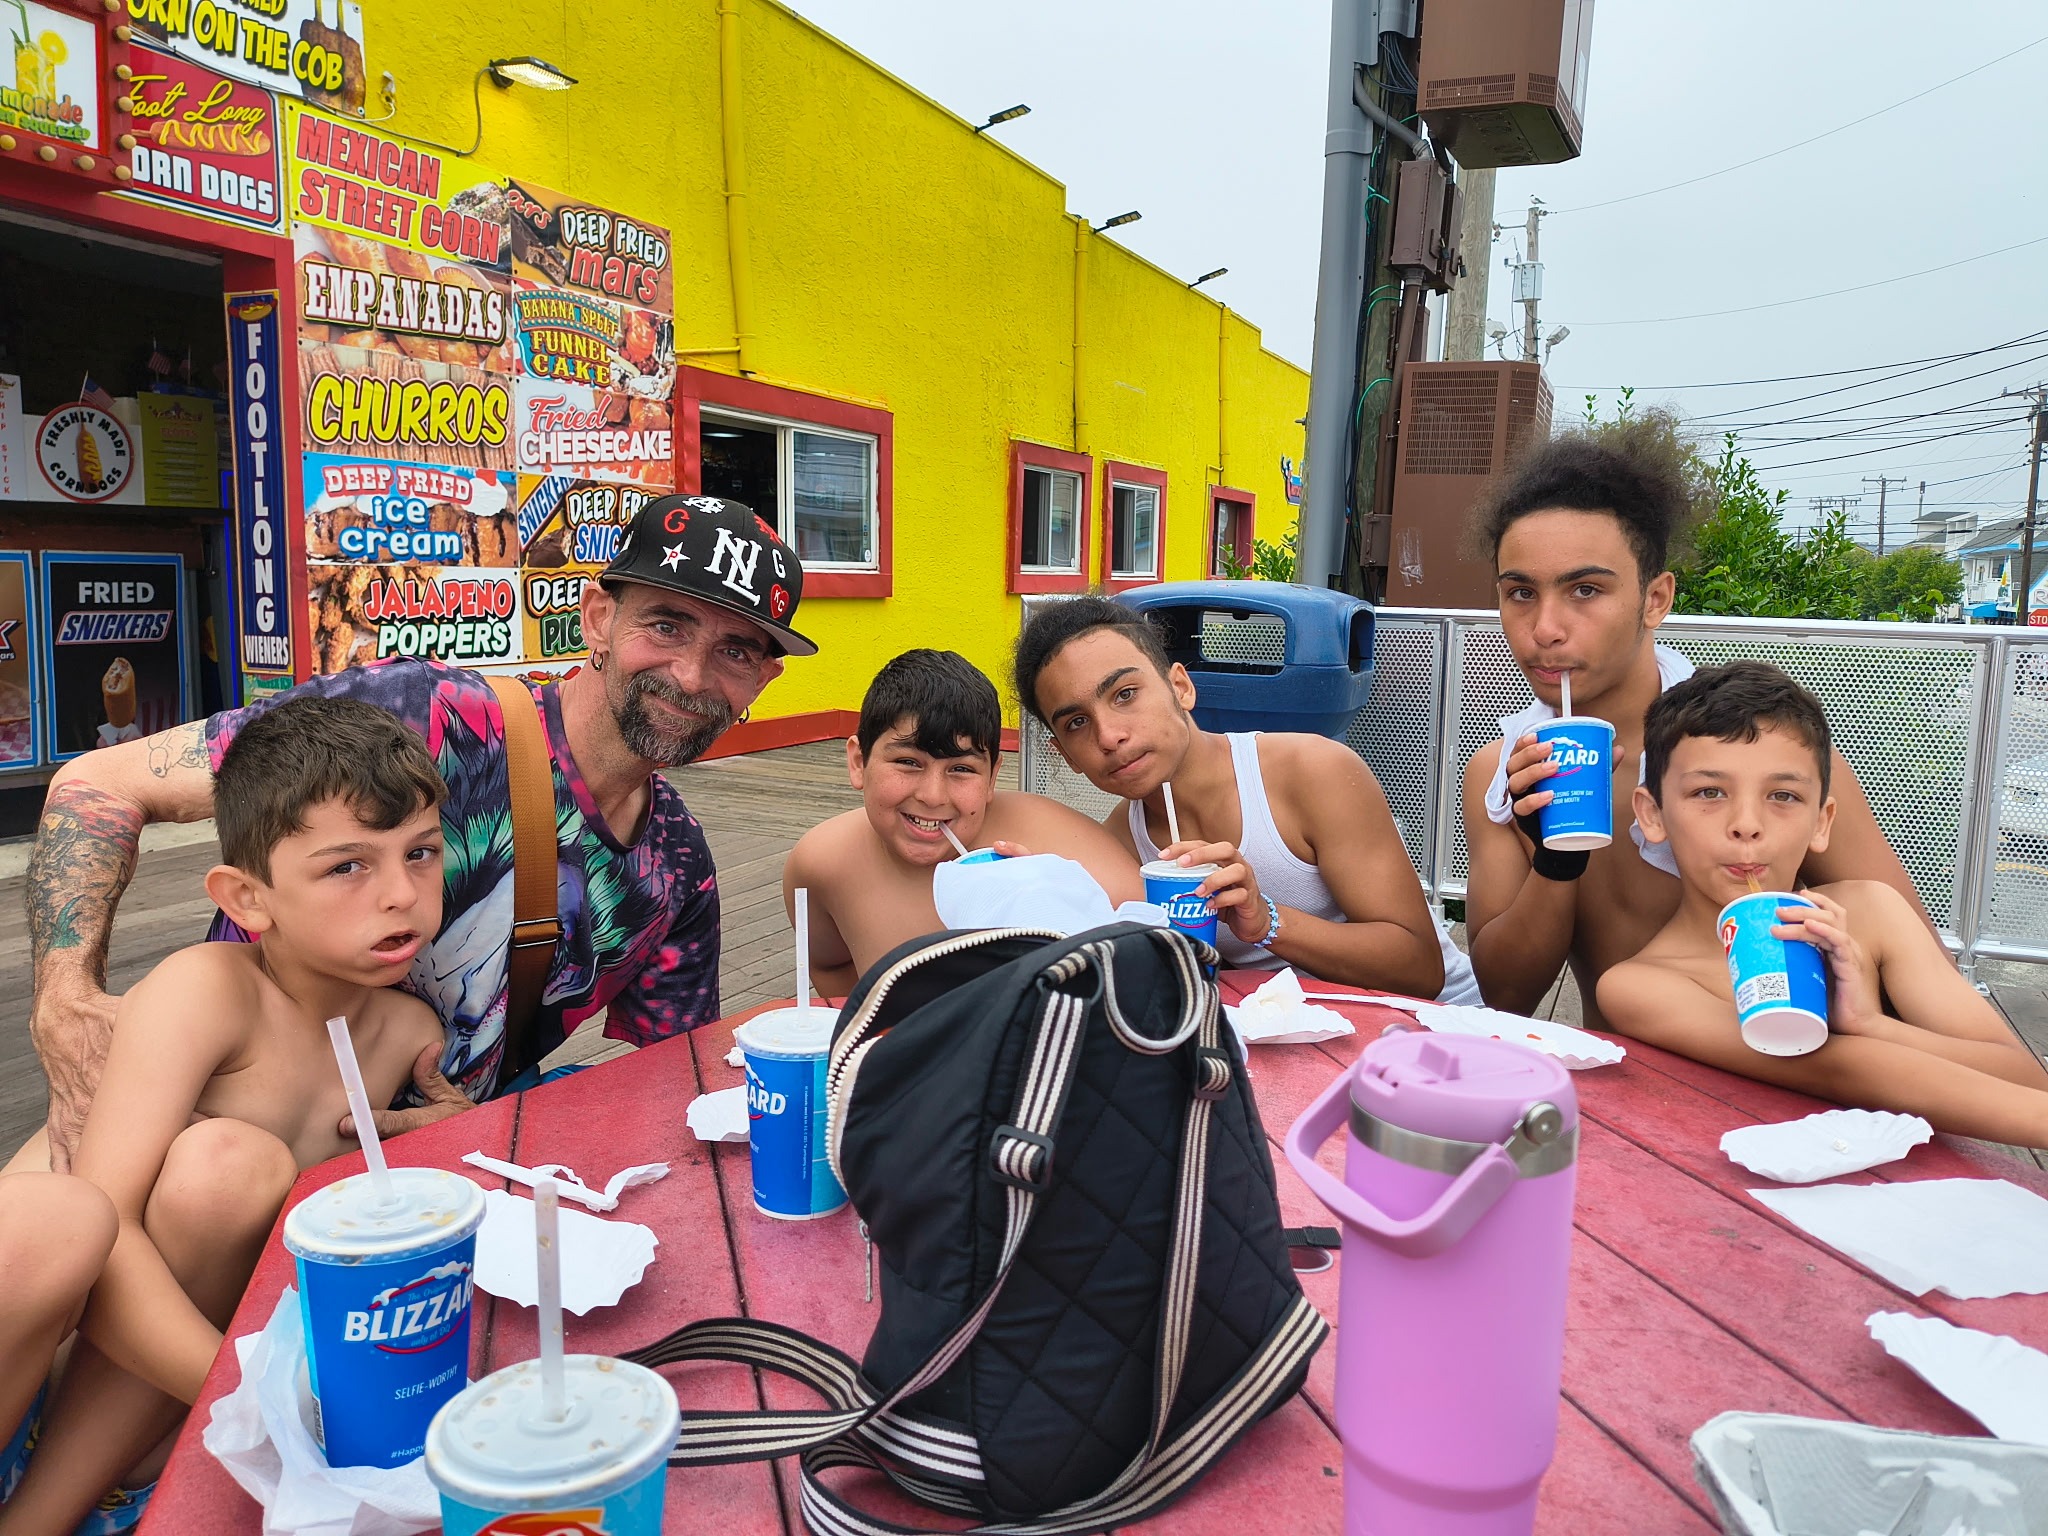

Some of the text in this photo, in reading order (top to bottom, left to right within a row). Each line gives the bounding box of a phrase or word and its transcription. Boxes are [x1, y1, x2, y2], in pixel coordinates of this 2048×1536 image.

[128, 0, 344, 91] ORN ON THE COB
[0, 86, 83, 124] monade
[129, 75, 266, 135] Foot Long
[20, 117, 91, 140] SQUEEZED
[296, 113, 441, 200] MEXICAN
[132, 145, 274, 215] ORN DOGS
[300, 169, 500, 266] STREET CORN
[508, 189, 552, 230] ars
[563, 211, 666, 268] DEEP FRIED
[570, 247, 659, 303] mars
[305, 263, 502, 341] EMPANADAS
[522, 299, 618, 338] BANANA SPLIT
[533, 330, 611, 364] FUNNEL
[533, 354, 610, 385] CAKE
[310, 376, 508, 445] CHURROS
[529, 394, 612, 434] Fried
[45, 411, 126, 457] FRESHLY MADE
[520, 430, 671, 465] CHEESECAKE
[50, 462, 85, 493] CORN
[324, 467, 471, 501] DEEP FRIED
[373, 497, 426, 525] ice
[517, 476, 574, 545] SNICKER
[568, 489, 614, 524] DEEP
[664, 508, 690, 534] C
[340, 530, 461, 557] cream
[576, 525, 621, 562] SNIC
[668, 551, 679, 561] P
[772, 549, 786, 579] G
[79, 582, 155, 604] FRIED
[364, 578, 514, 618] JALAPENO
[62, 613, 169, 642] SNICKERS
[2030, 615, 2048, 625] STO
[244, 635, 289, 666] WIENERS
[378, 622, 510, 659] POPPERS
[1546, 749, 1599, 767] ZARD
[343, 1271, 474, 1342] BLIZZAR
[394, 1363, 459, 1400] SELFIE-WORTHY
